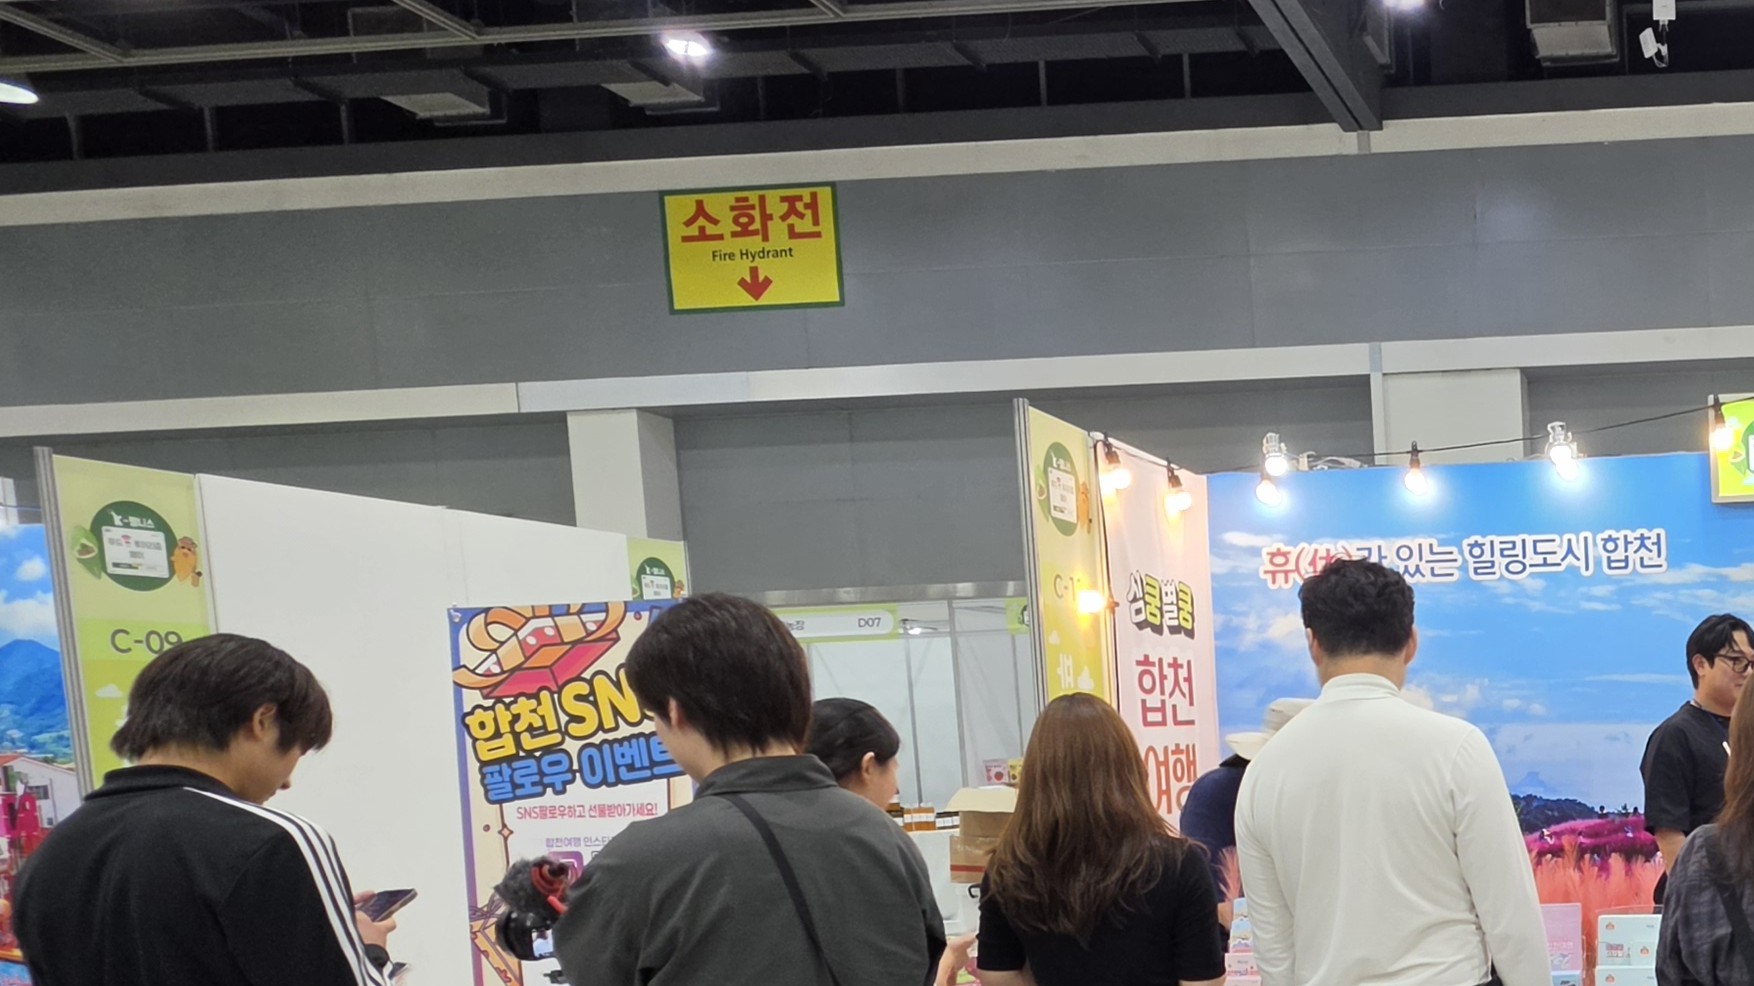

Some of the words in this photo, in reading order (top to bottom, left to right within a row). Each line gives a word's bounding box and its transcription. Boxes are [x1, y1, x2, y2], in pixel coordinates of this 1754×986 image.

[681, 191, 822, 243] 소화전
[712, 250, 736, 262] Fire
[740, 247, 794, 263] Hydrant
[1395, 542, 1458, 578] 있는
[1467, 536, 1589, 575] 힐링도시
[1600, 532, 1663, 570] 합천
[858, 617, 881, 628] D07
[465, 690, 562, 762] 합천
[560, 666, 656, 737] SN
[1136, 653, 1196, 728] 합천
[482, 752, 574, 801] 팔로우
[1143, 743, 1197, 815] 여행
